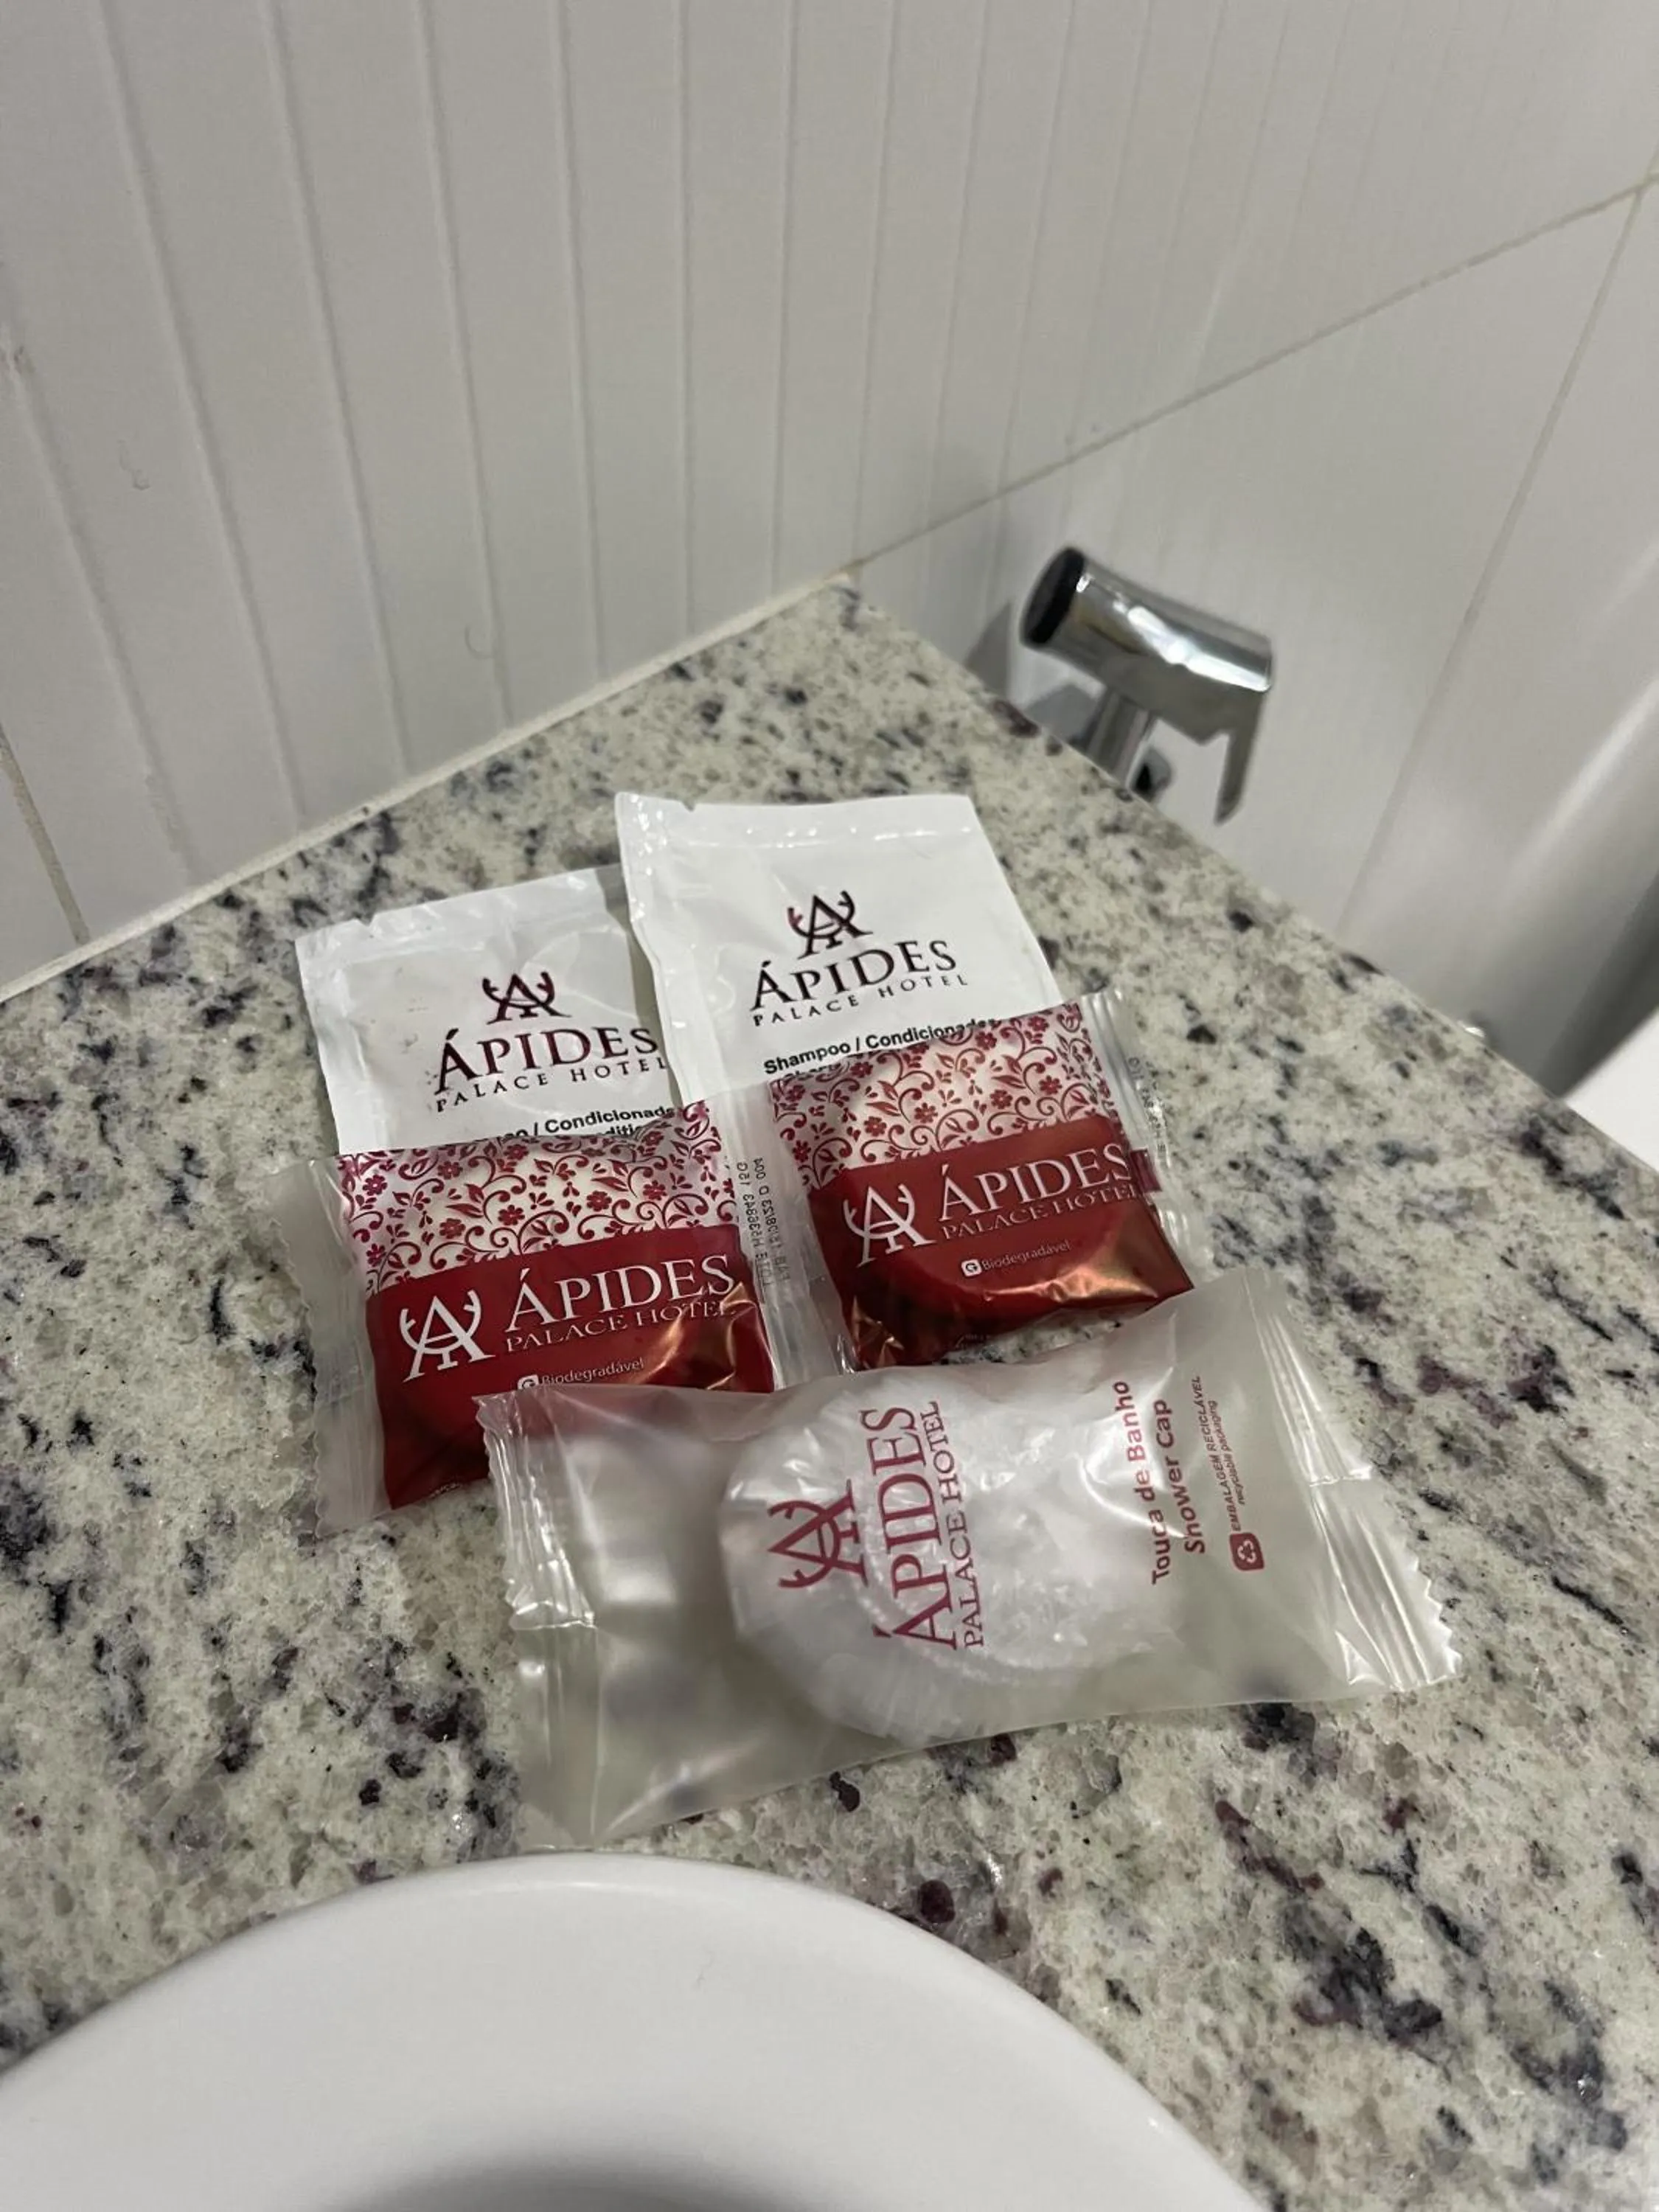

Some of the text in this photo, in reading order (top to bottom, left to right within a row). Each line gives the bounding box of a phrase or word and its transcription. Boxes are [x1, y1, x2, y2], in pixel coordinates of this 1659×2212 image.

[749, 940, 956, 1012] ÁPIDES
[753, 974, 968, 1026] PALACE HOTEL
[434, 1027, 658, 1096] ÁPIDES
[437, 1057, 667, 1113] PALACE HOTEL
[764, 1042, 850, 1075] Shampoo
[939, 1144, 1132, 1221] ÁPIDES
[942, 1183, 1144, 1240] PALACE HOTEL
[981, 1239, 1069, 1271] Biodegradável
[504, 1253, 735, 1333] ÁPIDES
[505, 1300, 737, 1352] PALACE HOTEL
[541, 1357, 644, 1386] Biodegradável
[1113, 1381, 1171, 1585] Touca de Banho
[1153, 1399, 1206, 1554] Shower Cap
[1192, 1376, 1242, 1531] EMBALAGEM RECICLÁVEL
[859, 1408, 957, 1650] ÁPIDES
[920, 1402, 984, 1649] PALACE HOTEL
